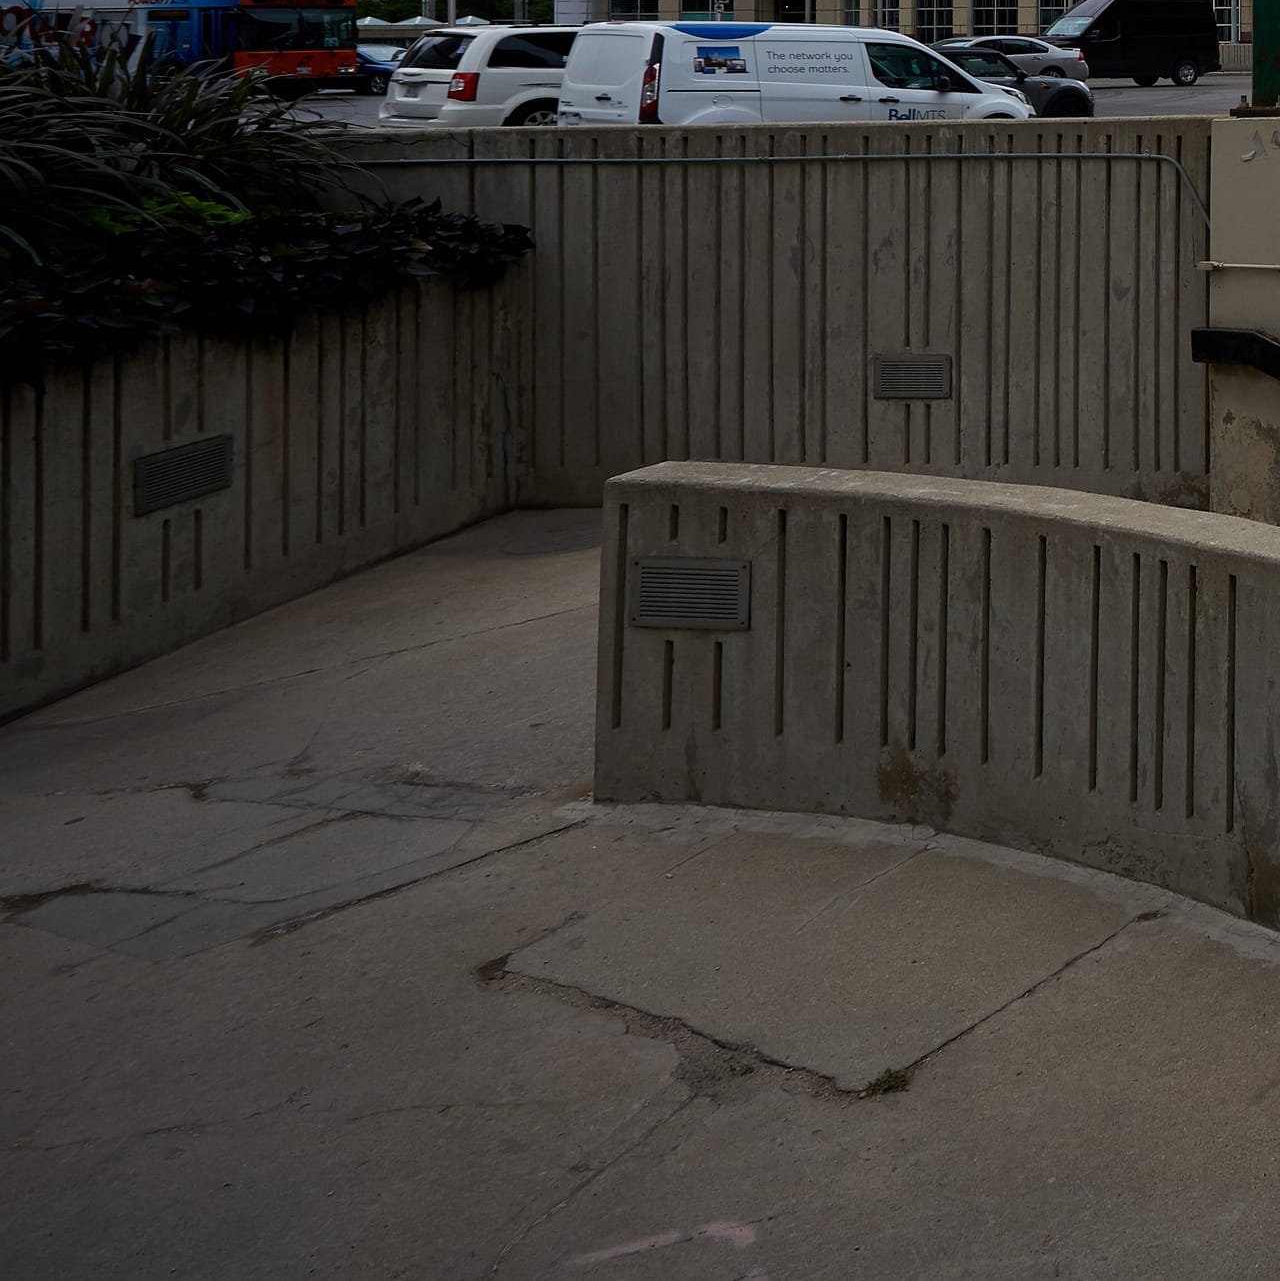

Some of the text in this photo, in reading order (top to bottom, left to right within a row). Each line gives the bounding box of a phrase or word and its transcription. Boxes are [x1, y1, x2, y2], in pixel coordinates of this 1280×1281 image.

[766, 50, 853, 63] The network you
[767, 65, 849, 74] choose matters.
